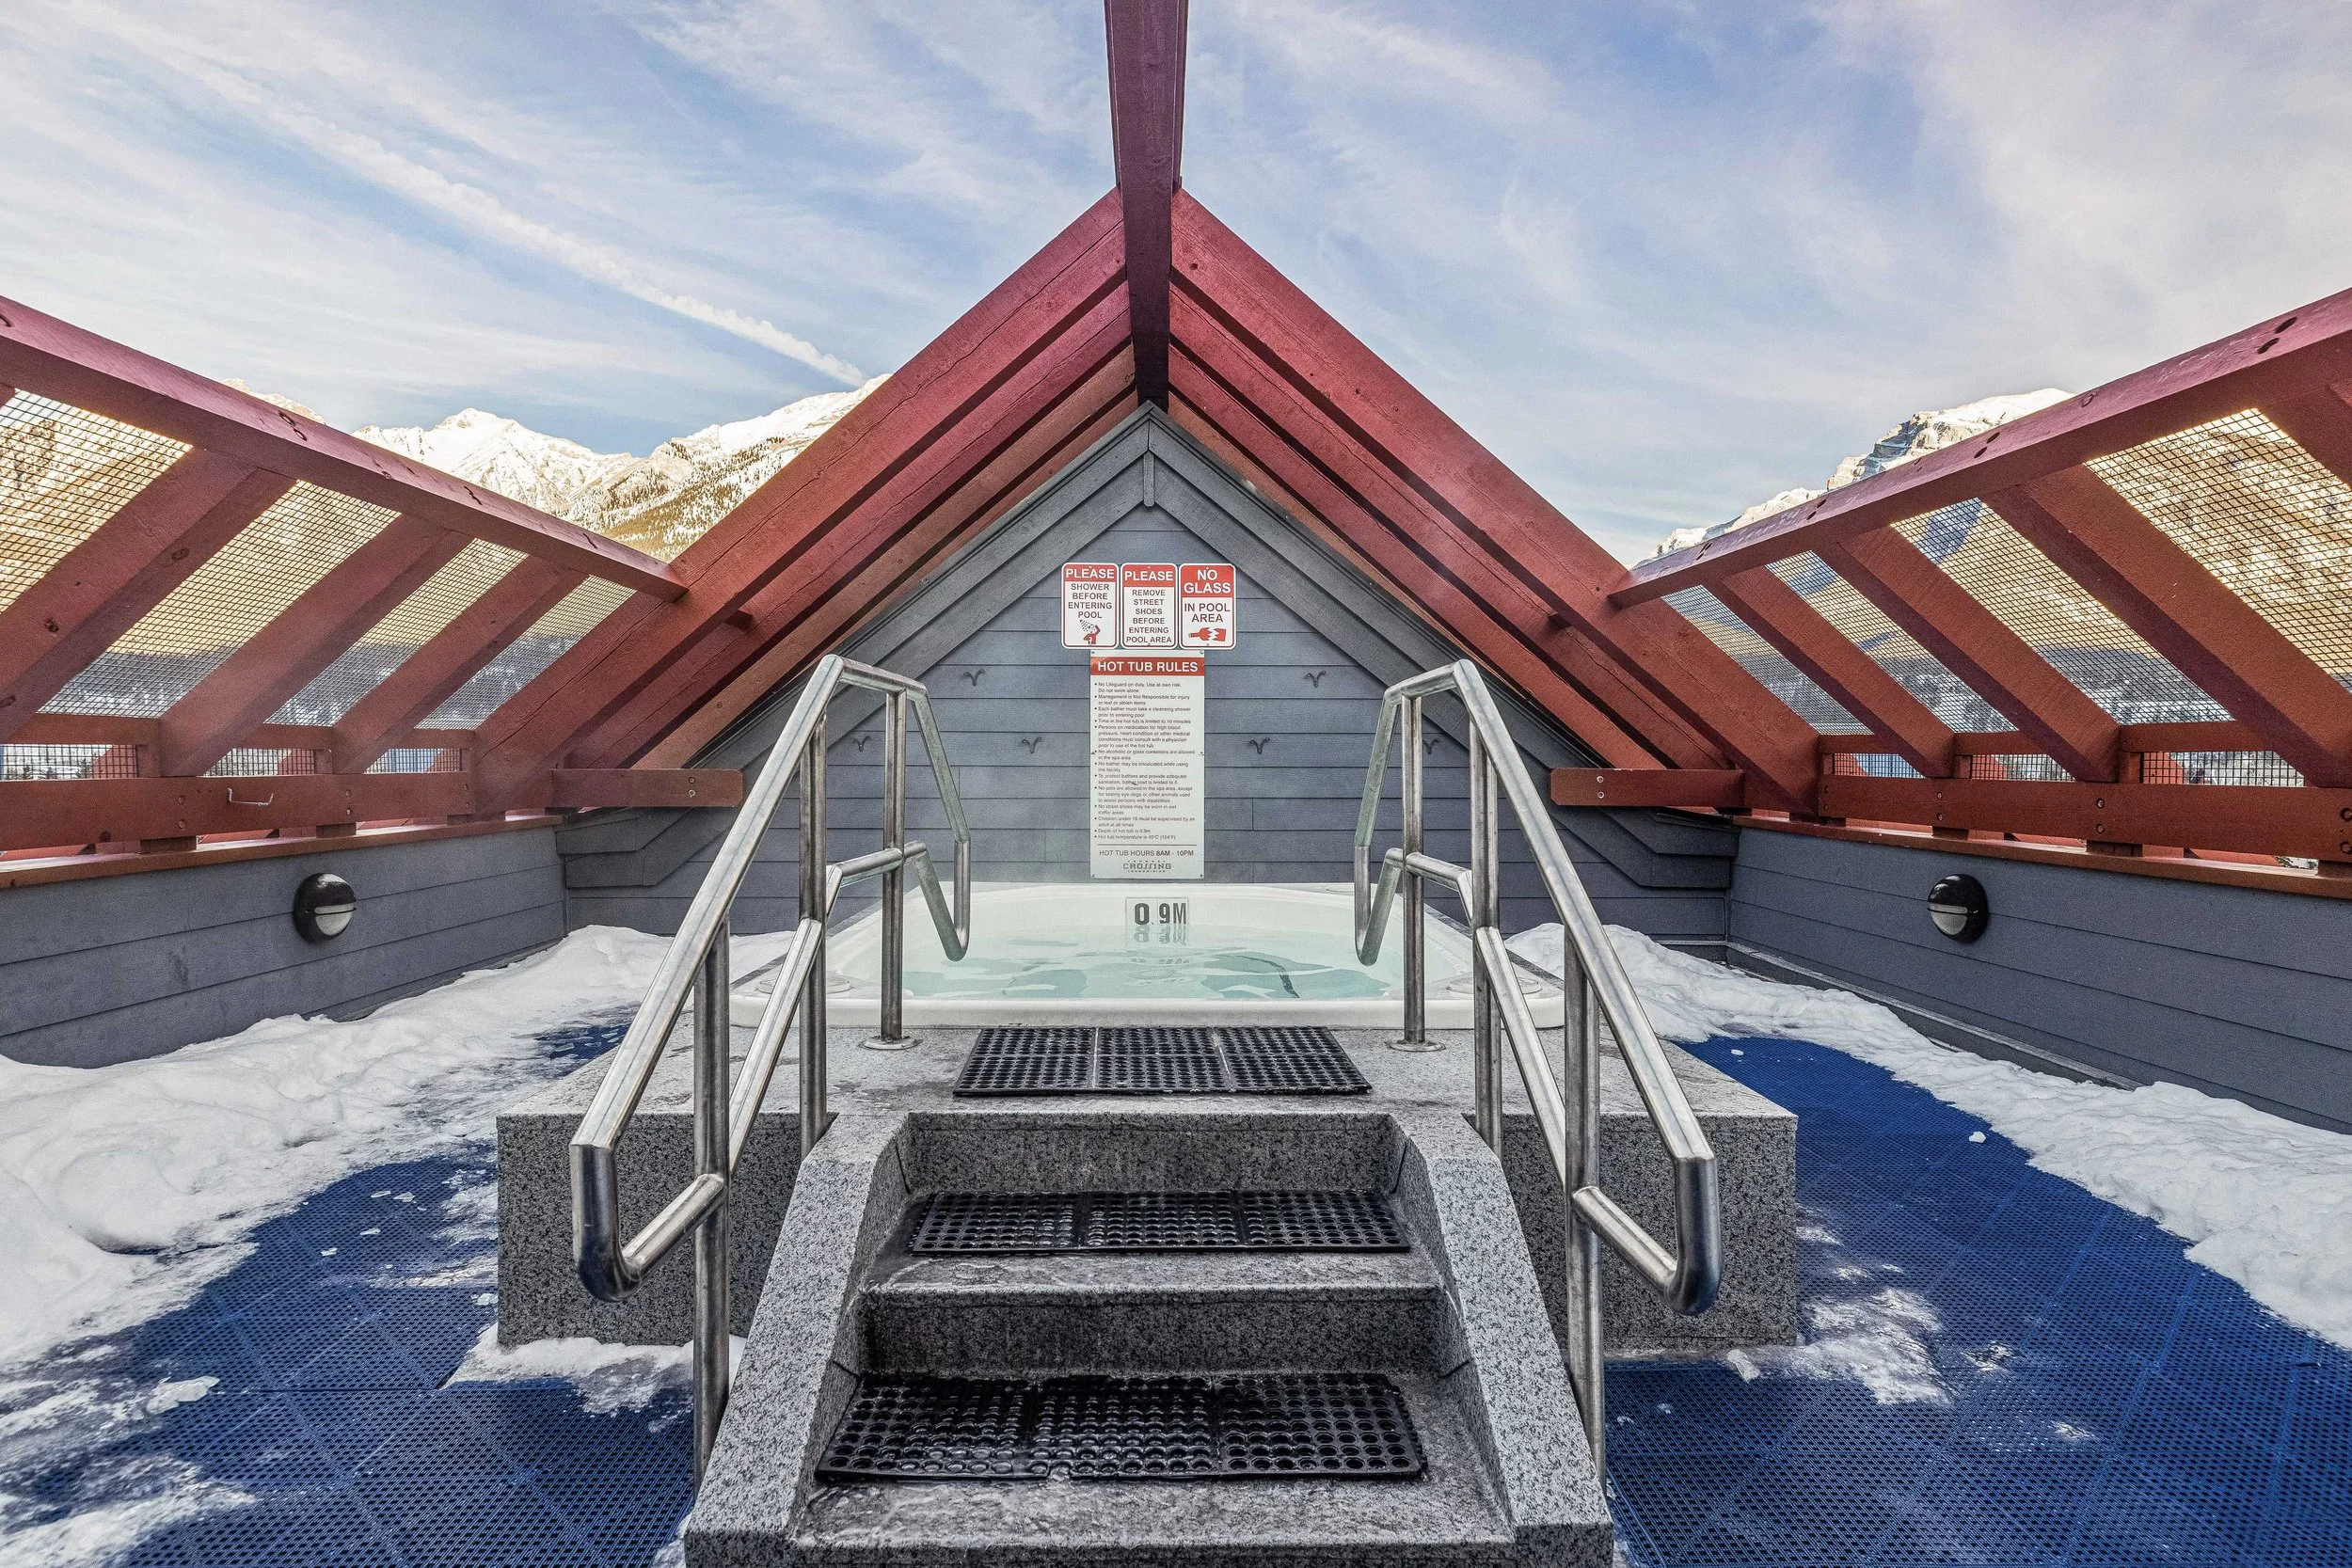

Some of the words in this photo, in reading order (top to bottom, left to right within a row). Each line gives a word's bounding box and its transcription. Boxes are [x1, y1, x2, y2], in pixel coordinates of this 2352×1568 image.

[1066, 569, 1115, 578] PLEASE
[1125, 571, 1173, 581] PLEASE
[1197, 570, 1217, 580] NO
[1184, 582, 1231, 594] GLASS
[1184, 603, 1195, 611] IN
[1199, 603, 1230, 611] POOL
[1191, 614, 1223, 623] AREA
[1097, 661, 1124, 672] HOT
[1128, 661, 1152, 672] TUB
[1157, 662, 1199, 672] RULES
[1134, 903, 1186, 925] 0.9M
